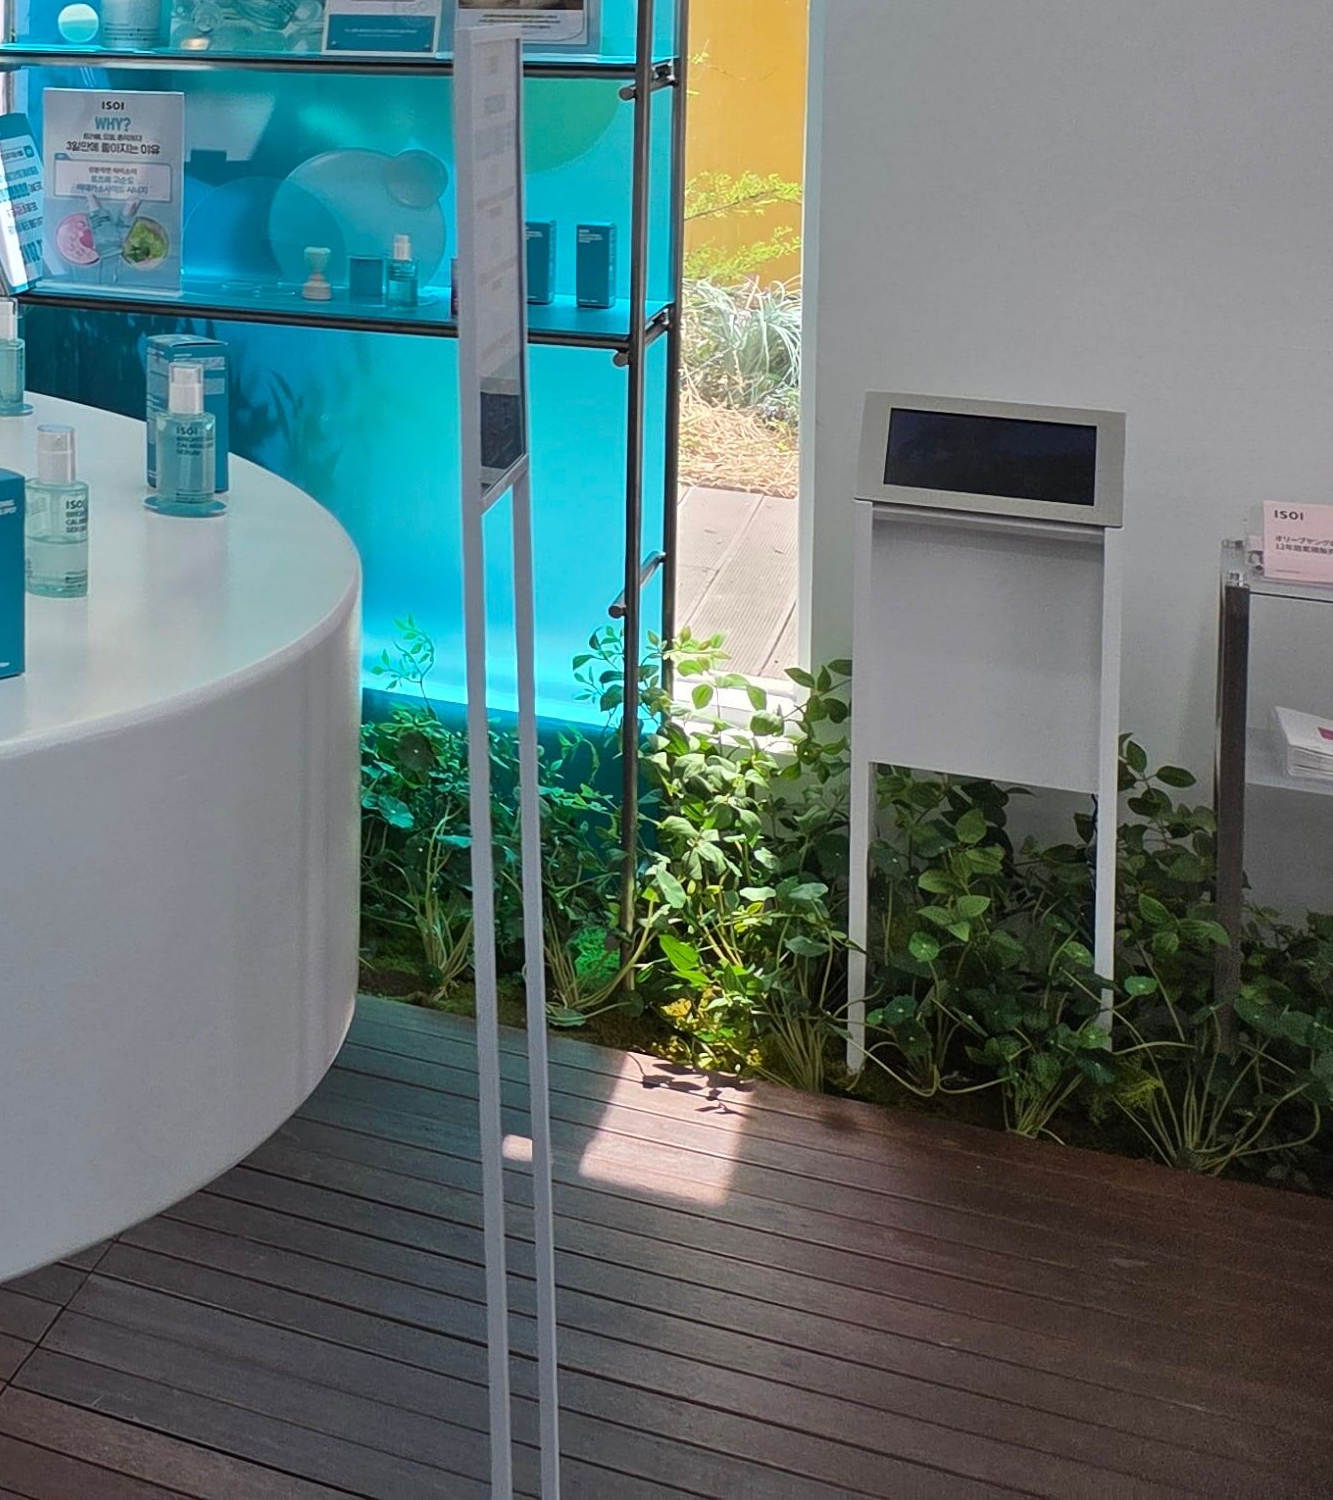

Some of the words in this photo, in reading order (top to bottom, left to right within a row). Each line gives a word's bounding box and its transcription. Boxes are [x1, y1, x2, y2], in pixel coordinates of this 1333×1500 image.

[101, 101, 124, 110] ISOI
[95, 116, 131, 131] WHY?
[1274, 510, 1304, 520] ISOI
